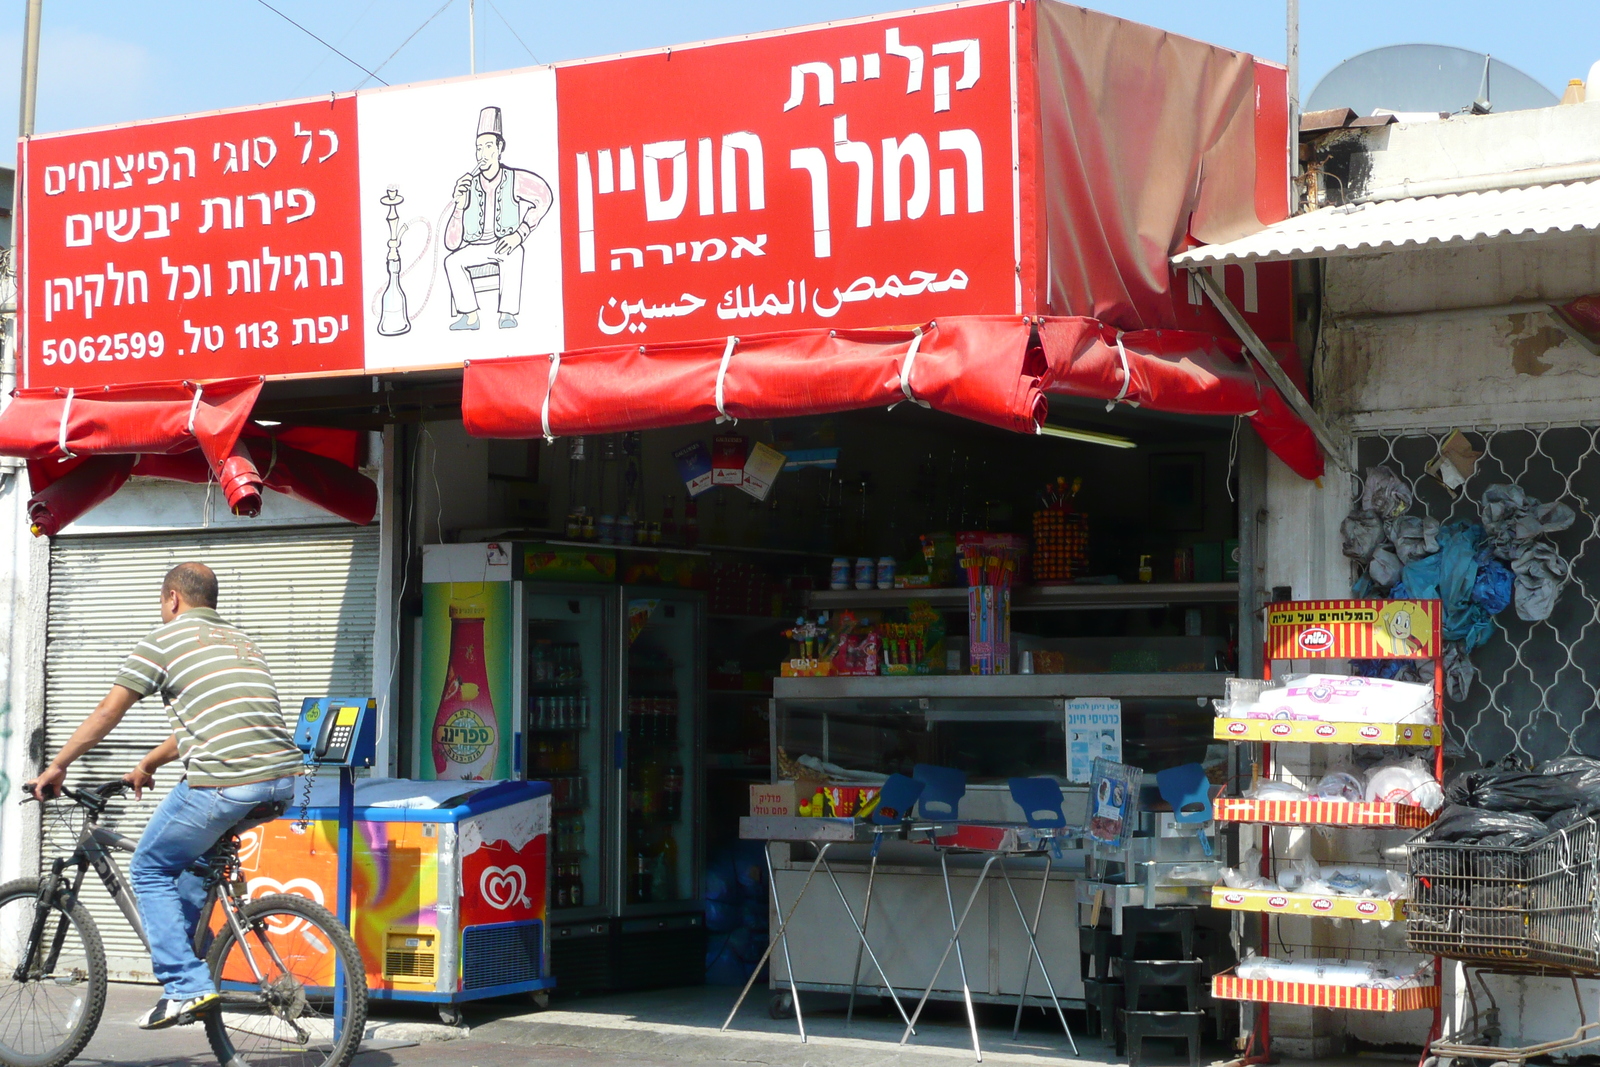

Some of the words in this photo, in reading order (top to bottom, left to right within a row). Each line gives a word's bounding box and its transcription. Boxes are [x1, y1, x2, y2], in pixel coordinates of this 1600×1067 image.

[783, 26, 981, 113] קליית
[212, 135, 278, 175] סוגי
[293, 121, 339, 164] כל
[44, 146, 196, 196] הפיצוחים
[789, 113, 984, 258] המלך
[198, 187, 316, 234] פירות
[575, 130, 767, 274] חוסיין
[65, 201, 180, 248] יבשים
[227, 246, 344, 295] נרגילות
[610, 233, 768, 271] אמירה
[44, 261, 149, 323] חלקיהן
[161, 256, 212, 301] וכל
[812, 267, 970, 318] محمص
[597, 292, 707, 335] حسين
[716, 278, 807, 320] الملك
[42, 330, 165, 366] 5062599
[178, 319, 225, 356] טל.
[235, 320, 279, 349] 113
[291, 314, 349, 346] יפת
[1272, 613, 1294, 624] עלית
[1297, 612, 1315, 622] של
[1318, 611, 1374, 622] המלוחים
[1068, 702, 1089, 710] להשיג
[1068, 714, 1087, 725] חיוג
[1088, 714, 1120, 725] כרטיסי
[1107, 703, 1119, 711] כאן
[440, 727, 489, 744] ספרינג
[771, 807, 788, 815] פחם
